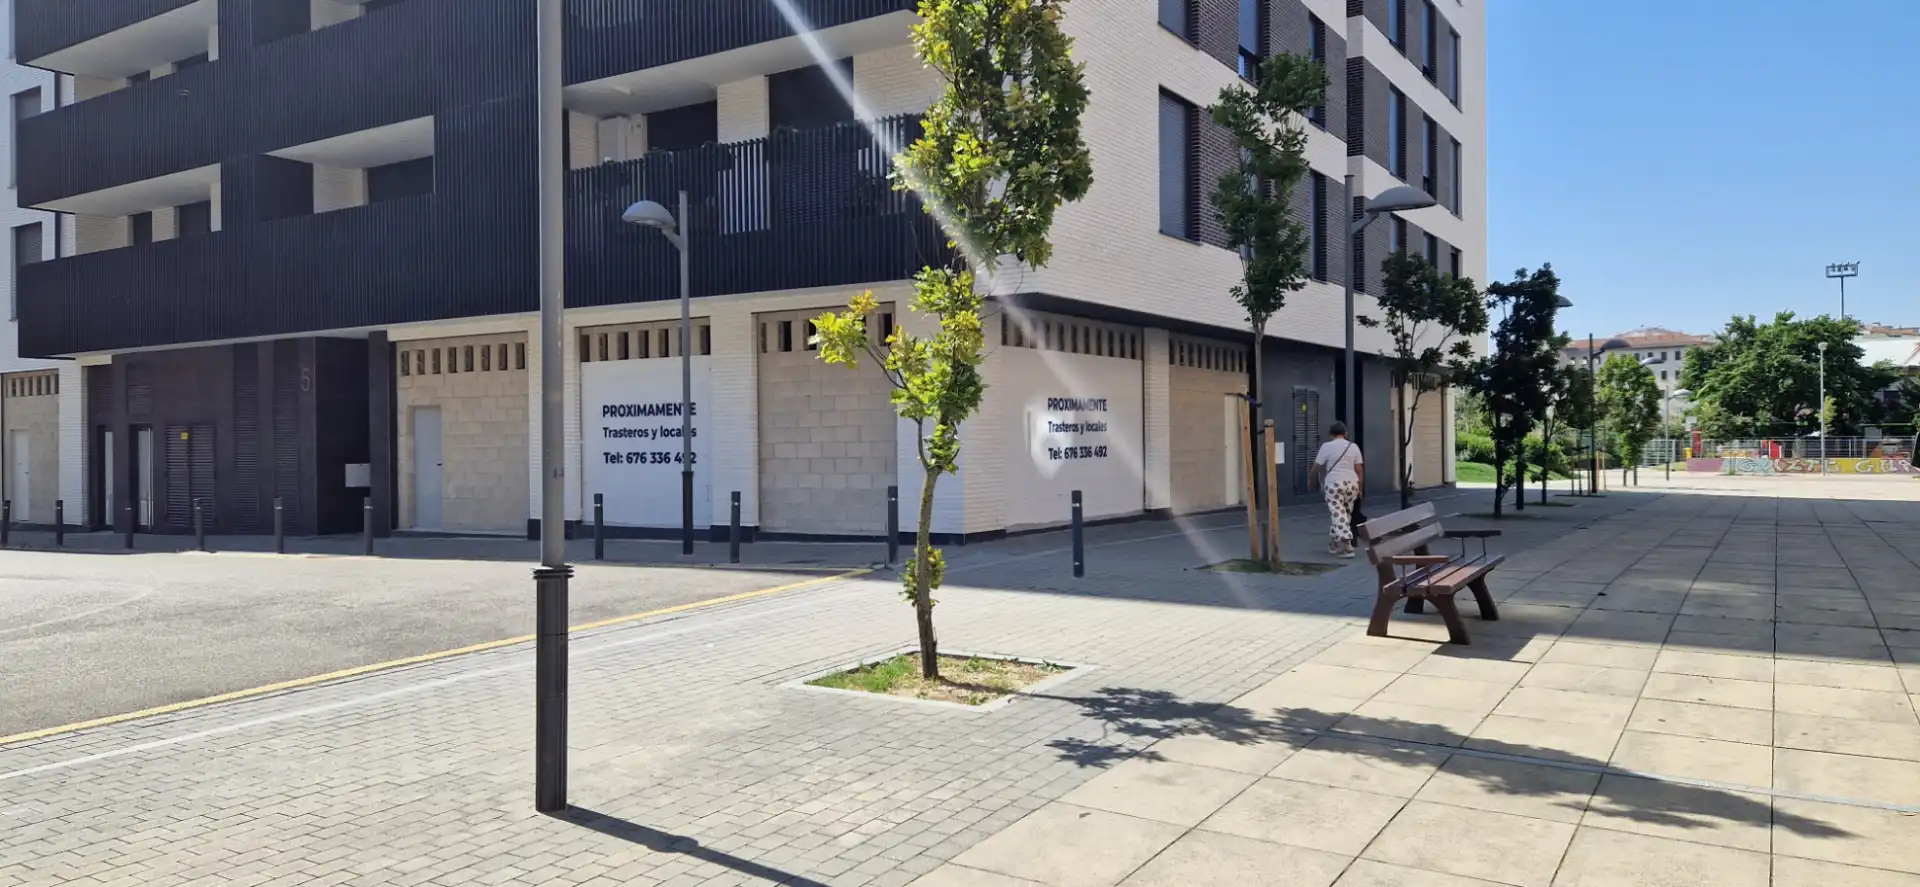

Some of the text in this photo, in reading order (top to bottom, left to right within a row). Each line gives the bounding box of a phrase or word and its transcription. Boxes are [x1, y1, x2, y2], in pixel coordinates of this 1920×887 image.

[301, 366, 311, 392] 5
[602, 402, 697, 418] PROXIMAMENE
[1047, 397, 1108, 412] PROXIMAMENTE
[602, 425, 697, 440] Trasteros y locals
[1047, 420, 1108, 435] Trasteros y locales
[602, 452, 697, 464] Tel: 676 336 42
[1048, 445, 1108, 460] Tel: 676 336 492
